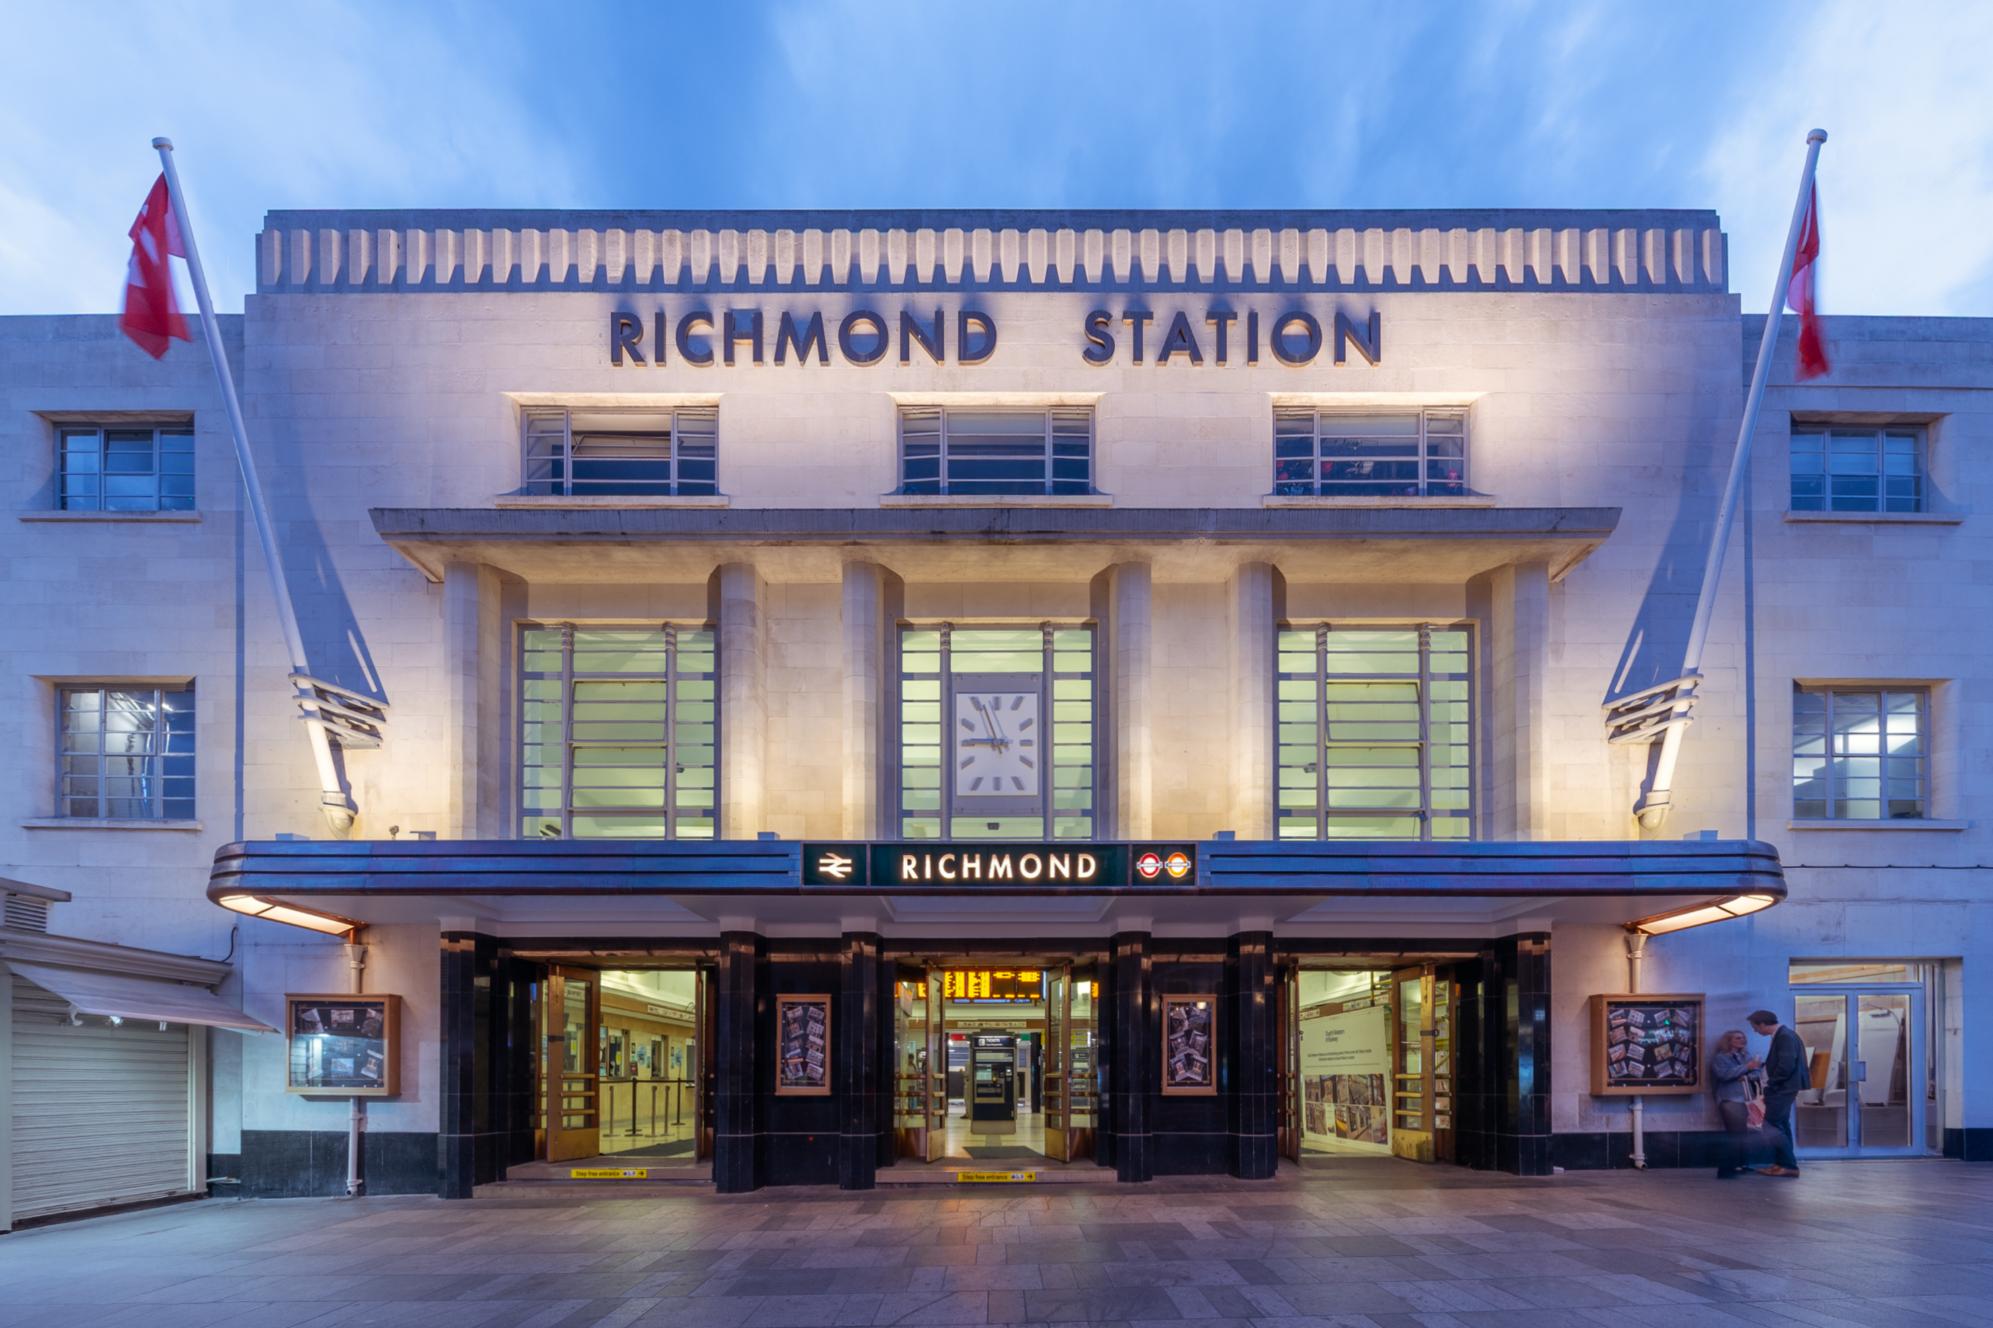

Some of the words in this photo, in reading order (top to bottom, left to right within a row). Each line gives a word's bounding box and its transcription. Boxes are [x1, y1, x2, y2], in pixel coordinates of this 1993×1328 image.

[610, 310, 997, 366] RICHMOND
[1082, 310, 1381, 366] STATION
[902, 853, 1097, 880] RICHMOND
